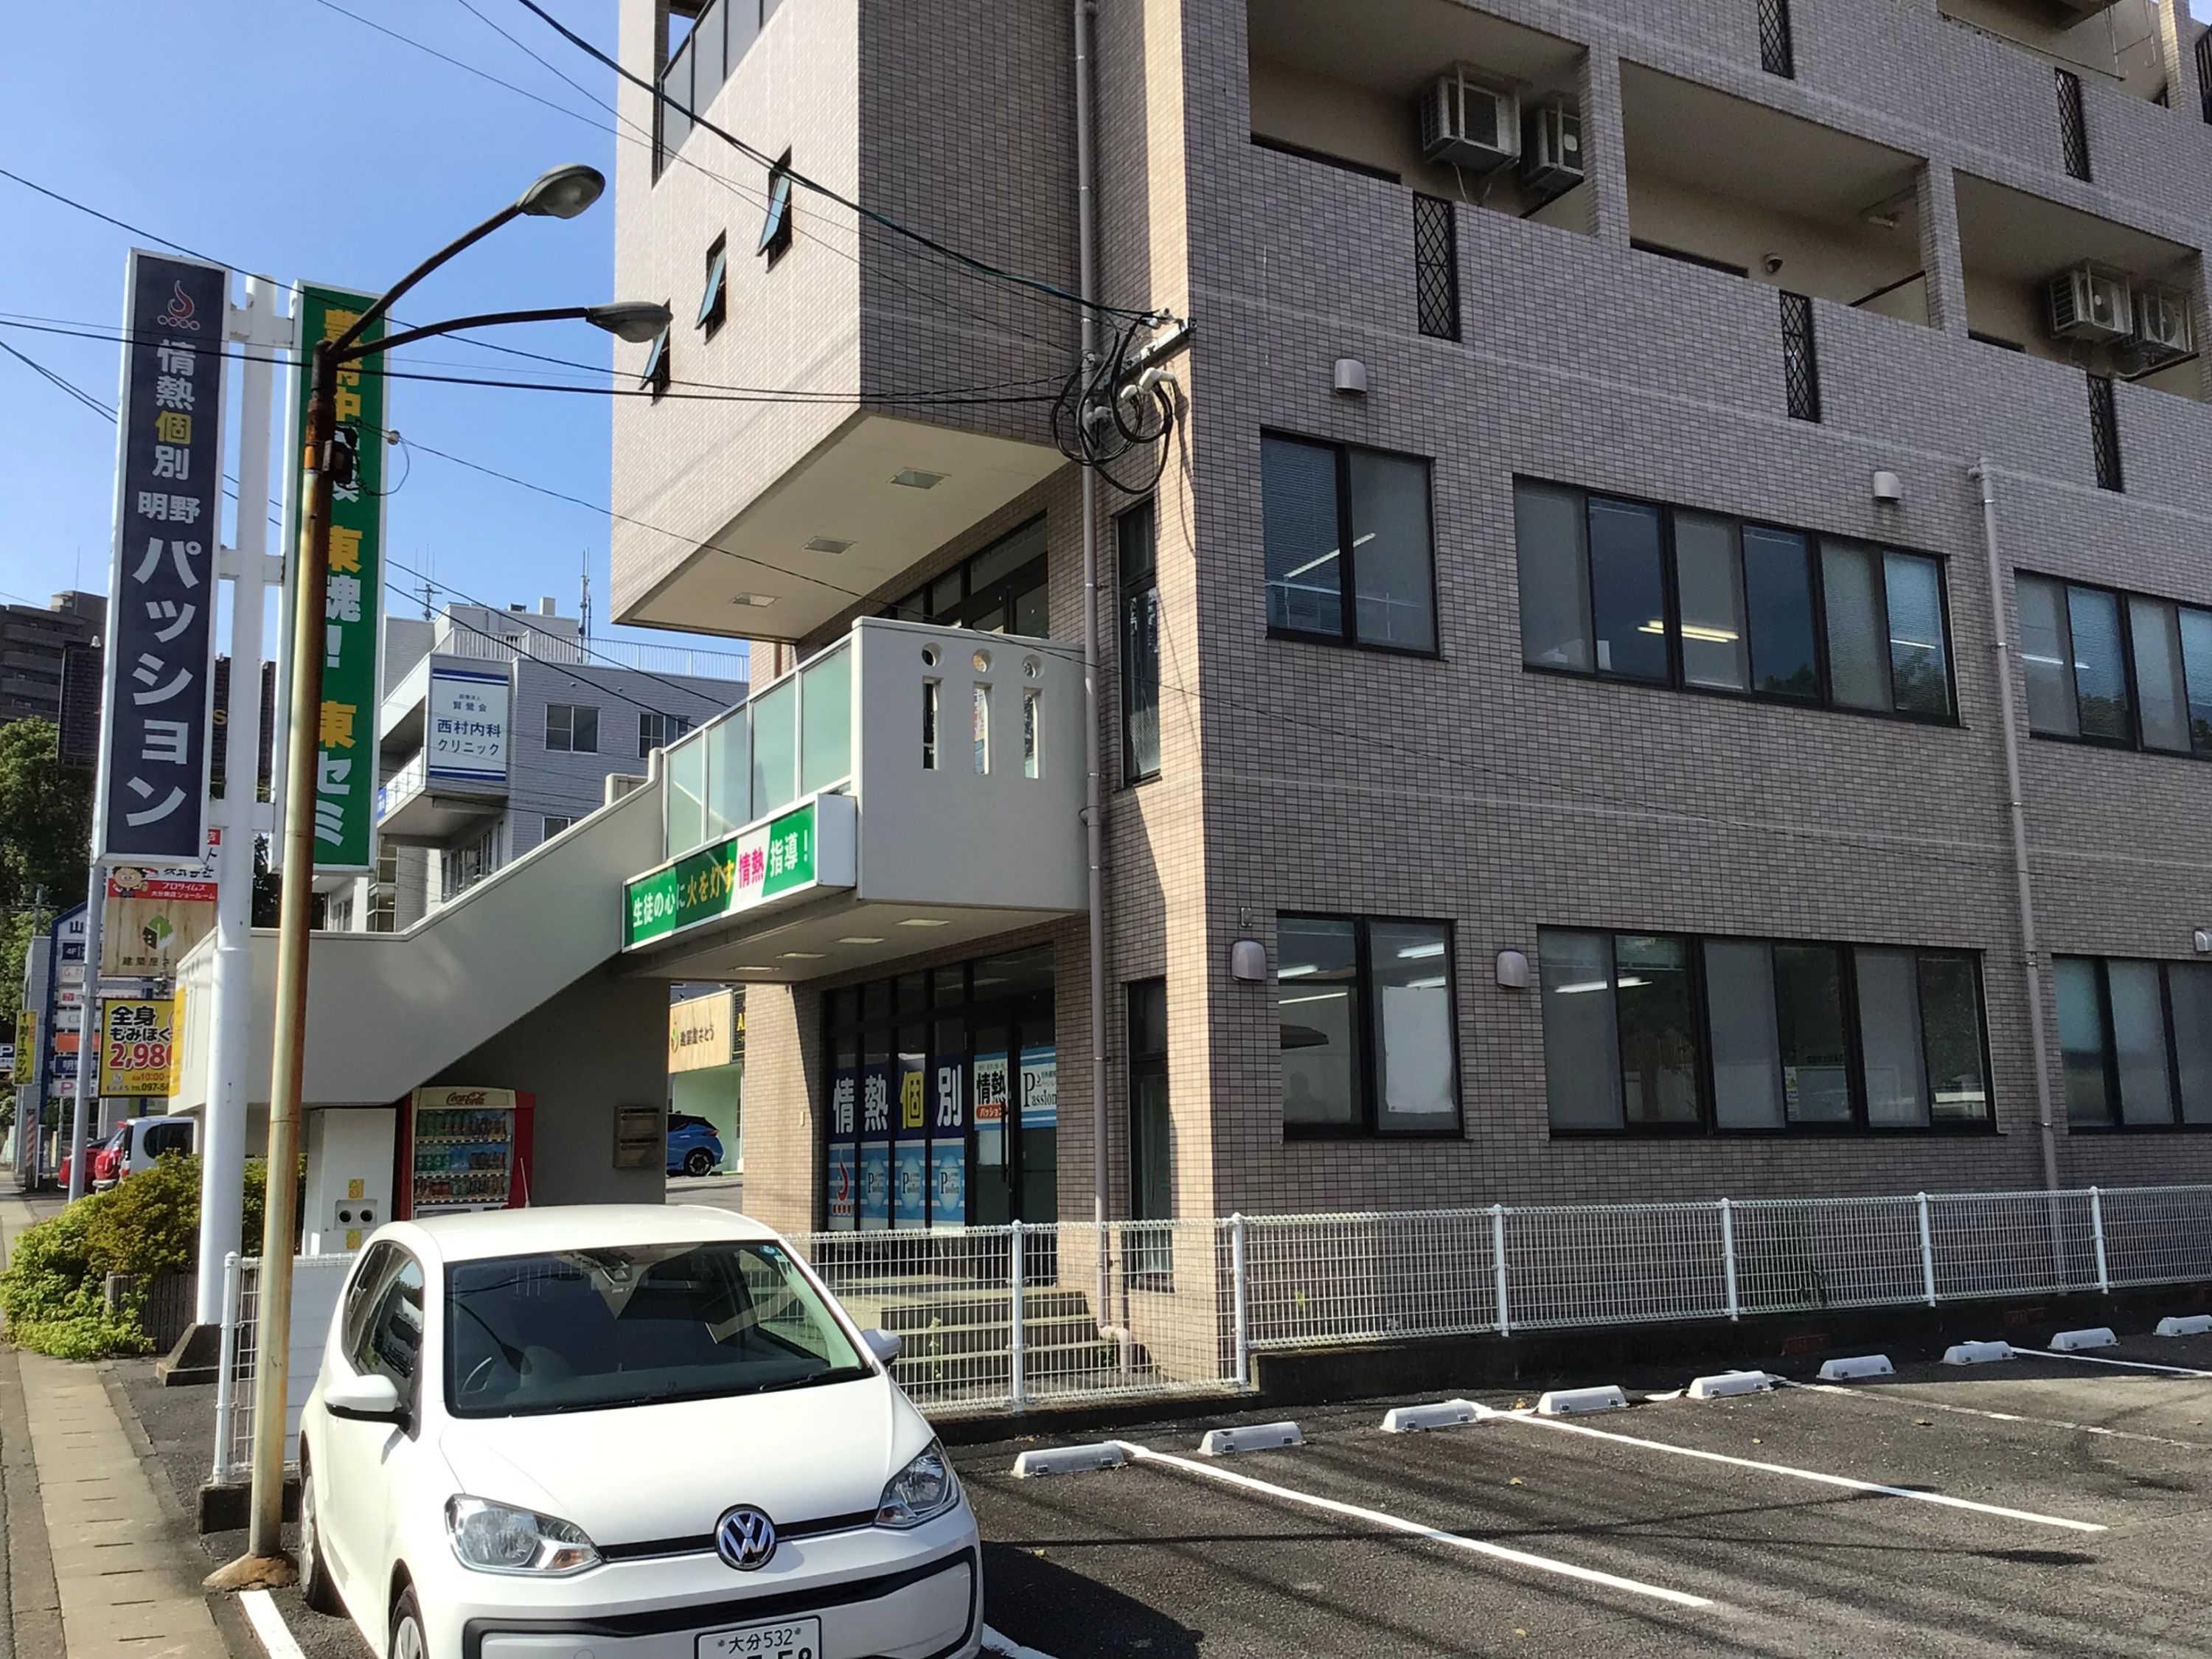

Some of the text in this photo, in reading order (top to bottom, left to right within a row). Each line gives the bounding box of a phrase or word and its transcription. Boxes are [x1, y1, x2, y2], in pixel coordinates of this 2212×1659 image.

[151, 338, 196, 481] 情熱個別
[137, 490, 201, 524] 明野
[125, 537, 202, 827] パッション
[437, 719, 501, 738] 西村内科
[437, 738, 499, 756] クリニック
[122, 957, 177, 967] 建築屋さ
[111, 1006, 156, 1026] 全身
[446, 1091, 487, 1105] Coca-Cola
[976, 1070, 1006, 1105] 情熱
[833, 1064, 962, 1134] 情熱個別
[764, 1628, 793, 1649] 532
